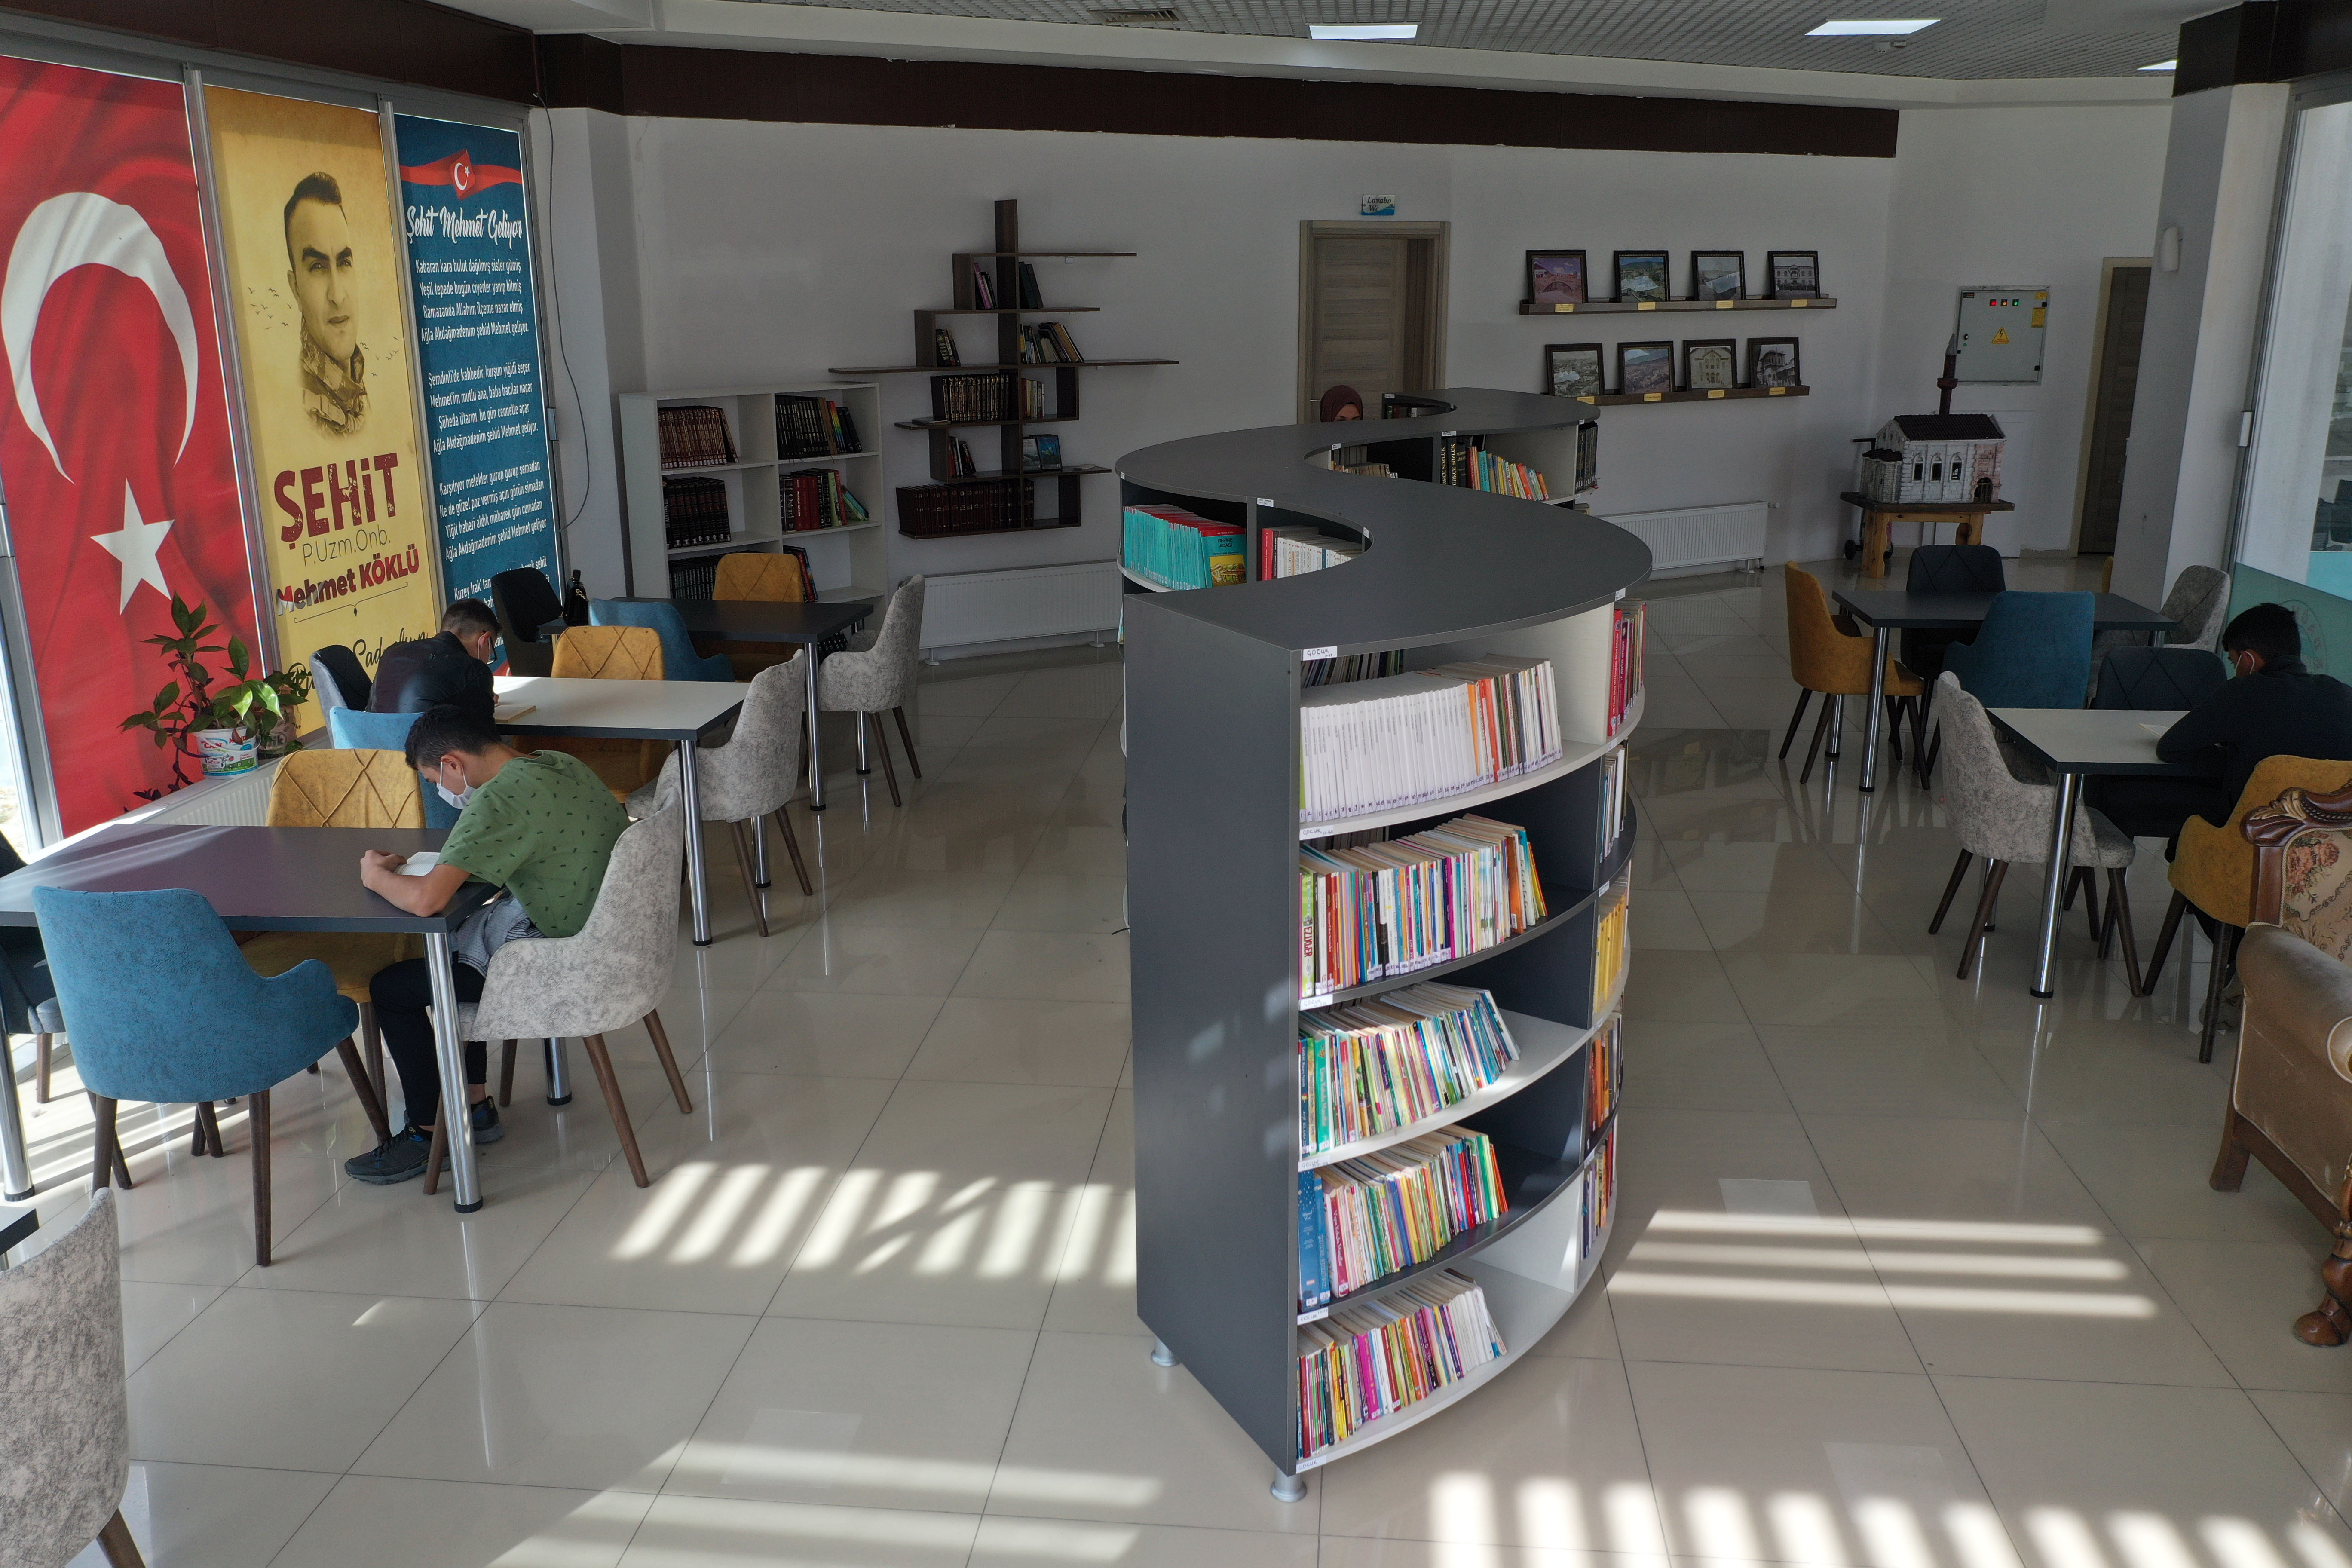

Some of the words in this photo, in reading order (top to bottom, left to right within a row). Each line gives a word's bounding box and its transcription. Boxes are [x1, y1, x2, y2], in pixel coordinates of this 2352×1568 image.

[406, 205, 439, 244] Şehit
[440, 206, 488, 244] Mehmet
[488, 209, 523, 250] Geliyor
[415, 259, 439, 273] Kabaran
[440, 259, 452, 273] kara
[453, 259, 468, 273] bulut
[469, 259, 490, 275] dağılmış
[492, 259, 505, 272] sisler
[506, 258, 521, 274] gitmiş
[419, 282, 434, 299] Yeşil
[435, 281, 453, 298] tepede
[454, 281, 471, 297] bugün
[472, 280, 491, 296] ciyerler
[493, 282, 506, 296] yanıp
[506, 279, 521, 294] bitmiş
[423, 303, 455, 319] Ramazanda
[456, 303, 476, 316] Allahım
[477, 302, 494, 317] ilçeme
[495, 304, 508, 314] nazar
[509, 300, 523, 315] etmiş
[421, 328, 434, 345] Ağla
[435, 324, 475, 343] Akdağmadenim
[476, 322, 490, 339] şehid
[491, 322, 511, 335] Mehmet
[511, 320, 529, 336] geliyor.
[461, 366, 485, 381] kahbedir,
[485, 365, 502, 380] kurşun
[518, 363, 530, 376] seçer
[461, 389, 476, 404] mutlu
[478, 389, 488, 400] ana,
[489, 385, 501, 398] baba
[502, 383, 518, 396] bacılar
[520, 383, 533, 395] naçar
[438, 413, 459, 432] Şüheda
[479, 409, 486, 422] bu
[487, 407, 497, 423] gün
[497, 404, 518, 418] cennette
[519, 403, 530, 416] açar
[433, 438, 446, 456] Ağla
[447, 430, 486, 450] Akdağmadenim
[487, 427, 501, 444] şehid
[501, 423, 521, 438] Mehmet
[521, 420, 538, 437] geliyor.
[439, 479, 465, 496] Karşılıyor
[466, 472, 489, 489] melekler
[490, 470, 504, 486] gurup
[505, 466, 519, 482] gurup
[520, 459, 540, 475] semadan
[274, 452, 398, 550] ŞEHİT
[439, 505, 447, 518] Ne
[448, 502, 455, 515] de
[456, 497, 471, 517] güzel
[471, 497, 481, 512] poz
[481, 490, 499, 505] vermiş
[499, 493, 510, 502] açın
[510, 483, 524, 501] görün
[525, 478, 544, 493] simadan
[445, 523, 458, 540] Yiğit
[459, 517, 476, 534] haberi
[477, 513, 490, 529] aldık
[490, 506, 511, 524] mübarek
[512, 504, 521, 521] gün
[522, 499, 543, 515] cumadan
[303, 524, 391, 567] P.Uzm.Onb.
[446, 547, 458, 562] Ağla
[459, 534, 497, 555] Akdağmadenim
[498, 527, 511, 545] şehid
[511, 522, 531, 538] Mehmet
[531, 518, 547, 535] geliyor
[276, 569, 357, 616] Mehmet
[359, 543, 419, 589] KÖKLÜ
[454, 586, 470, 601] Kuzey
[483, 579, 491, 590] tan
